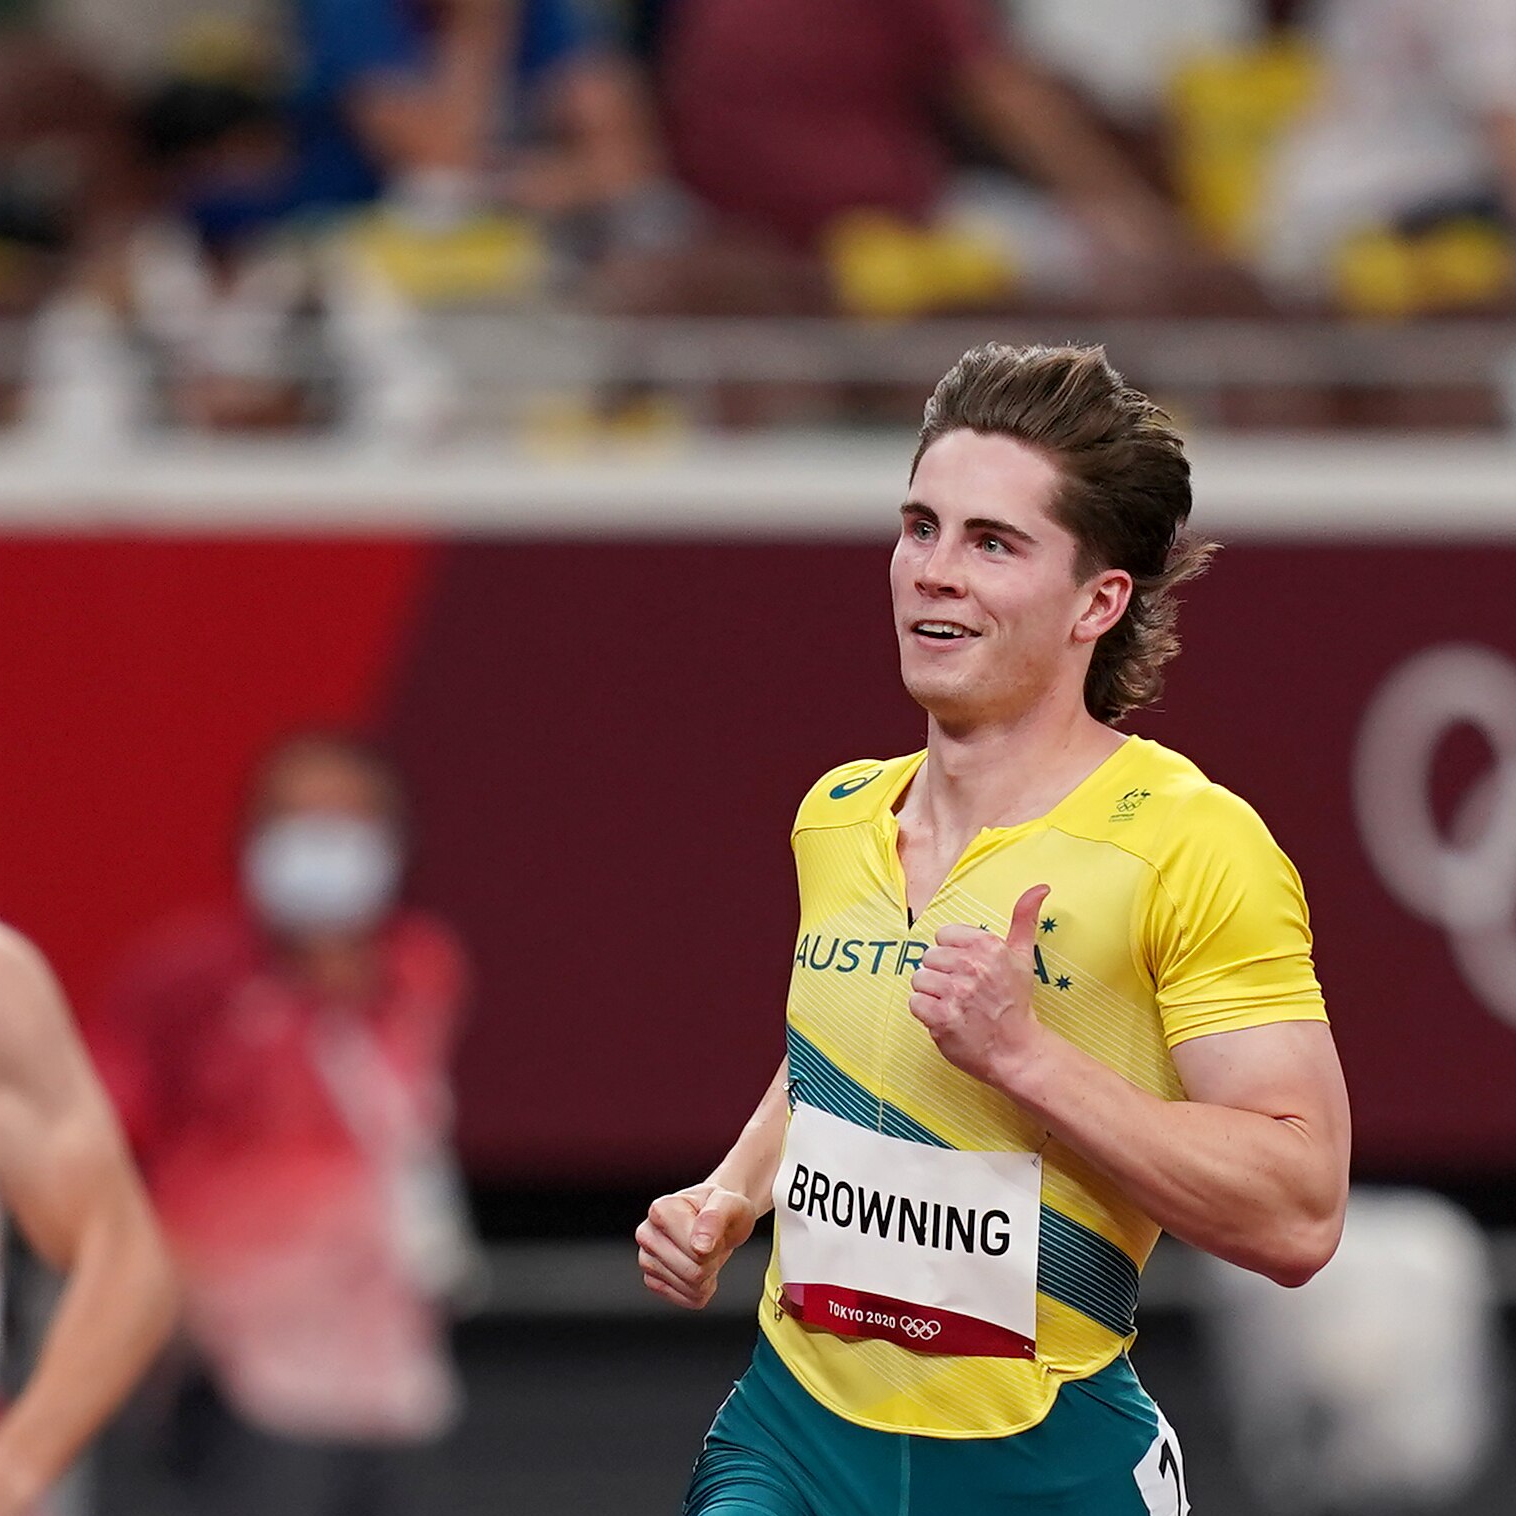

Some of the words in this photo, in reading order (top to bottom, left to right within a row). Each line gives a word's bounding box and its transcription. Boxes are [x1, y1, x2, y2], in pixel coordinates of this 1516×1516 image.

[794, 933, 1051, 985] AUSTRA
[787, 1163, 1011, 1257] BROWNING
[827, 1299, 865, 1322] TOKYO
[866, 1310, 897, 1330] 2020
